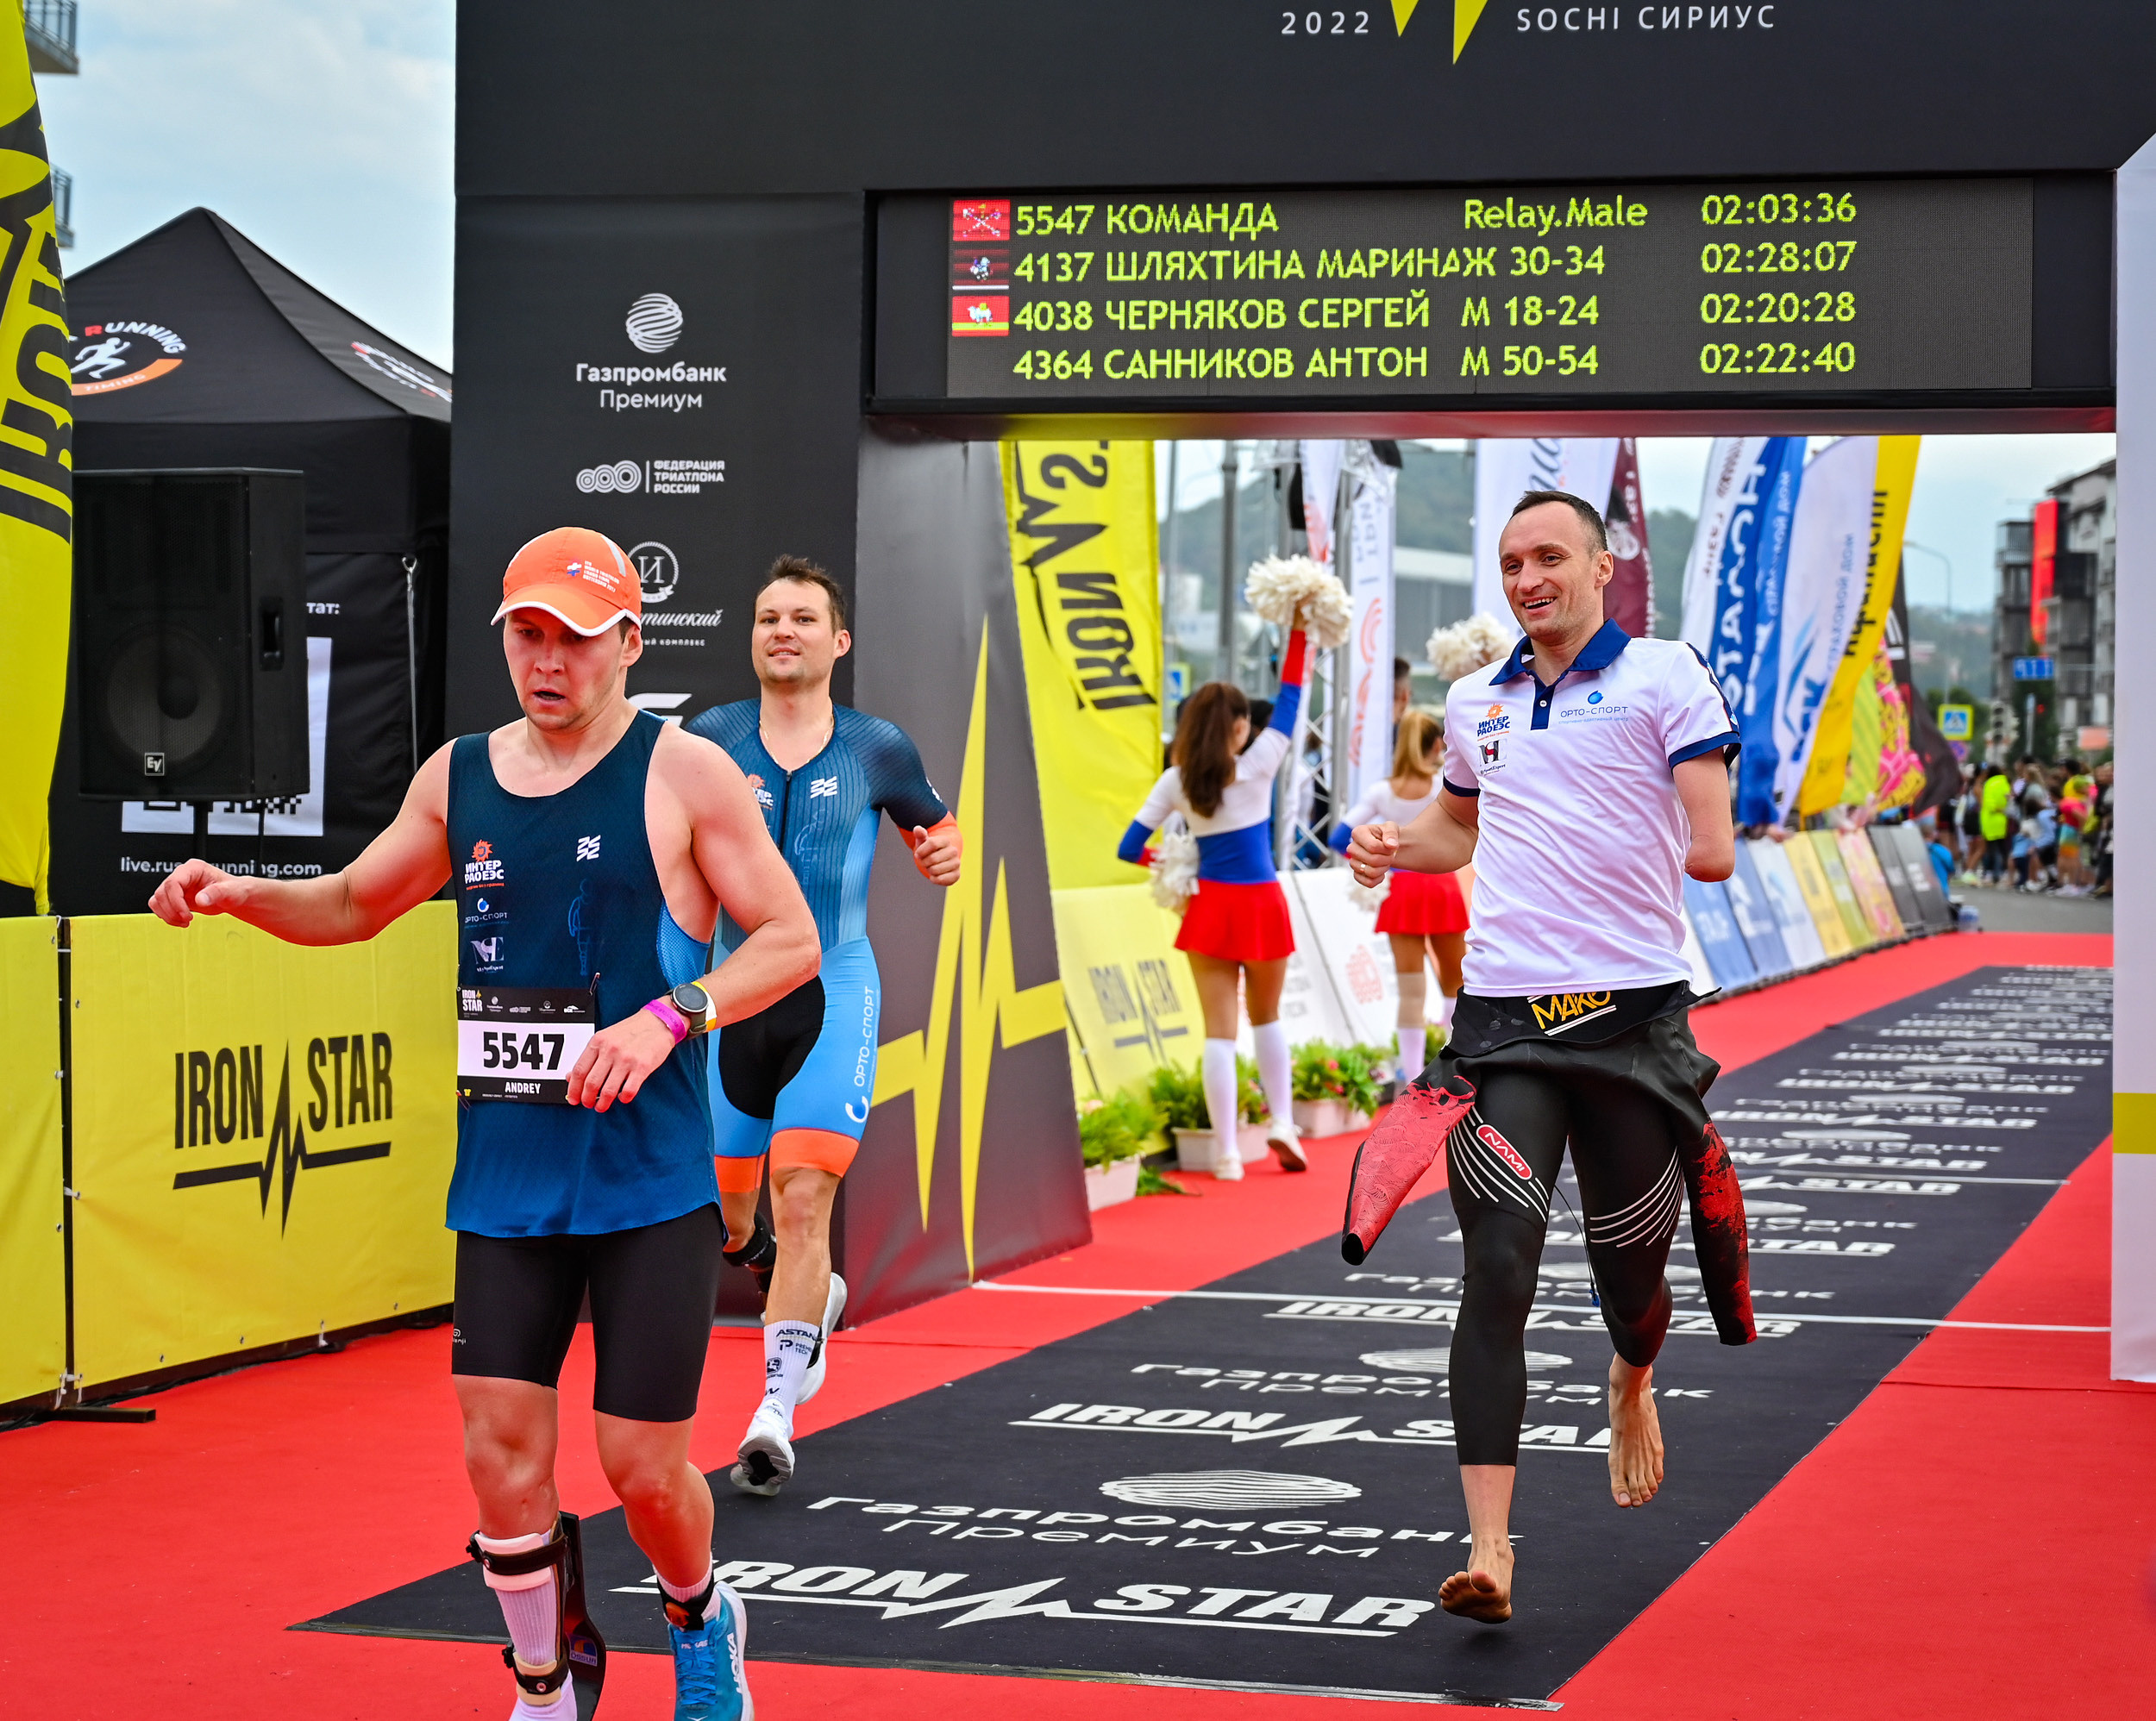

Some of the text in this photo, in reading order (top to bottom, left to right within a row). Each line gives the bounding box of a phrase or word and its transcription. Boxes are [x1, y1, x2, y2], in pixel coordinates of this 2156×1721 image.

[1281, 12, 1370, 34] 2022
[1517, 5, 1775, 31] SOCHI СИРИУС
[1016, 192, 1857, 241] 5547 КОМАНДА Relay.Male 02:03:36
[1013, 251, 1094, 283] 4137
[1106, 249, 1305, 281] ШЛЯХТИНА
[1510, 245, 1605, 277] 30-34
[1701, 241, 1857, 273] 02:28:07
[1013, 300, 1094, 331] 4038
[1106, 298, 1287, 330] ЧЕРНЯКОВ
[1298, 289, 1429, 328] СЕРГЕЙ
[1504, 295, 1600, 325] 18-24
[1700, 291, 1857, 323] 02:20:28
[85, 322, 187, 354] RUNNING
[1012, 348, 1094, 380] 4364
[1104, 347, 1294, 379] САННИКОВ
[1305, 347, 1427, 378] АНТОН
[1502, 345, 1600, 375] 50-54
[1700, 341, 1857, 374] 02:22:40
[85, 374, 147, 391] TIMING
[576, 361, 726, 385] Газпромбанк
[600, 389, 702, 412] Премиум
[654, 460, 725, 471] ФЕДЕРАЦИЯ
[654, 472, 724, 482] ТРИАТЛОНА
[654, 484, 700, 493] РОССИИ
[641, 609, 724, 627] тинский
[1560, 706, 1629, 717] ОРТО-СПОРТ
[1476, 722, 1511, 737] РАОЕЭС
[1478, 716, 1509, 729] ИНТЕР
[465, 860, 502, 873] ИНТЕР
[464, 869, 505, 885] РАОЕЭС
[461, 989, 476, 998] IRON
[462, 999, 483, 1012] STAR
[1532, 991, 1611, 1029] MAKO
[854, 986, 874, 1087] ОРТО-СПОРТ
[483, 1031, 565, 1071] 5547
[174, 1031, 393, 1149] IRON STAR
[505, 1081, 541, 1094] ANDREY
[1797, 1178, 1961, 1193] STAR
[1748, 1238, 1896, 1252] TAR
[776, 1329, 818, 1342] ASTAN
[1028, 1403, 1286, 1430] IRON
[881, 1519, 1380, 1558] Премиум
[1093, 1584, 1436, 1627] STAR
